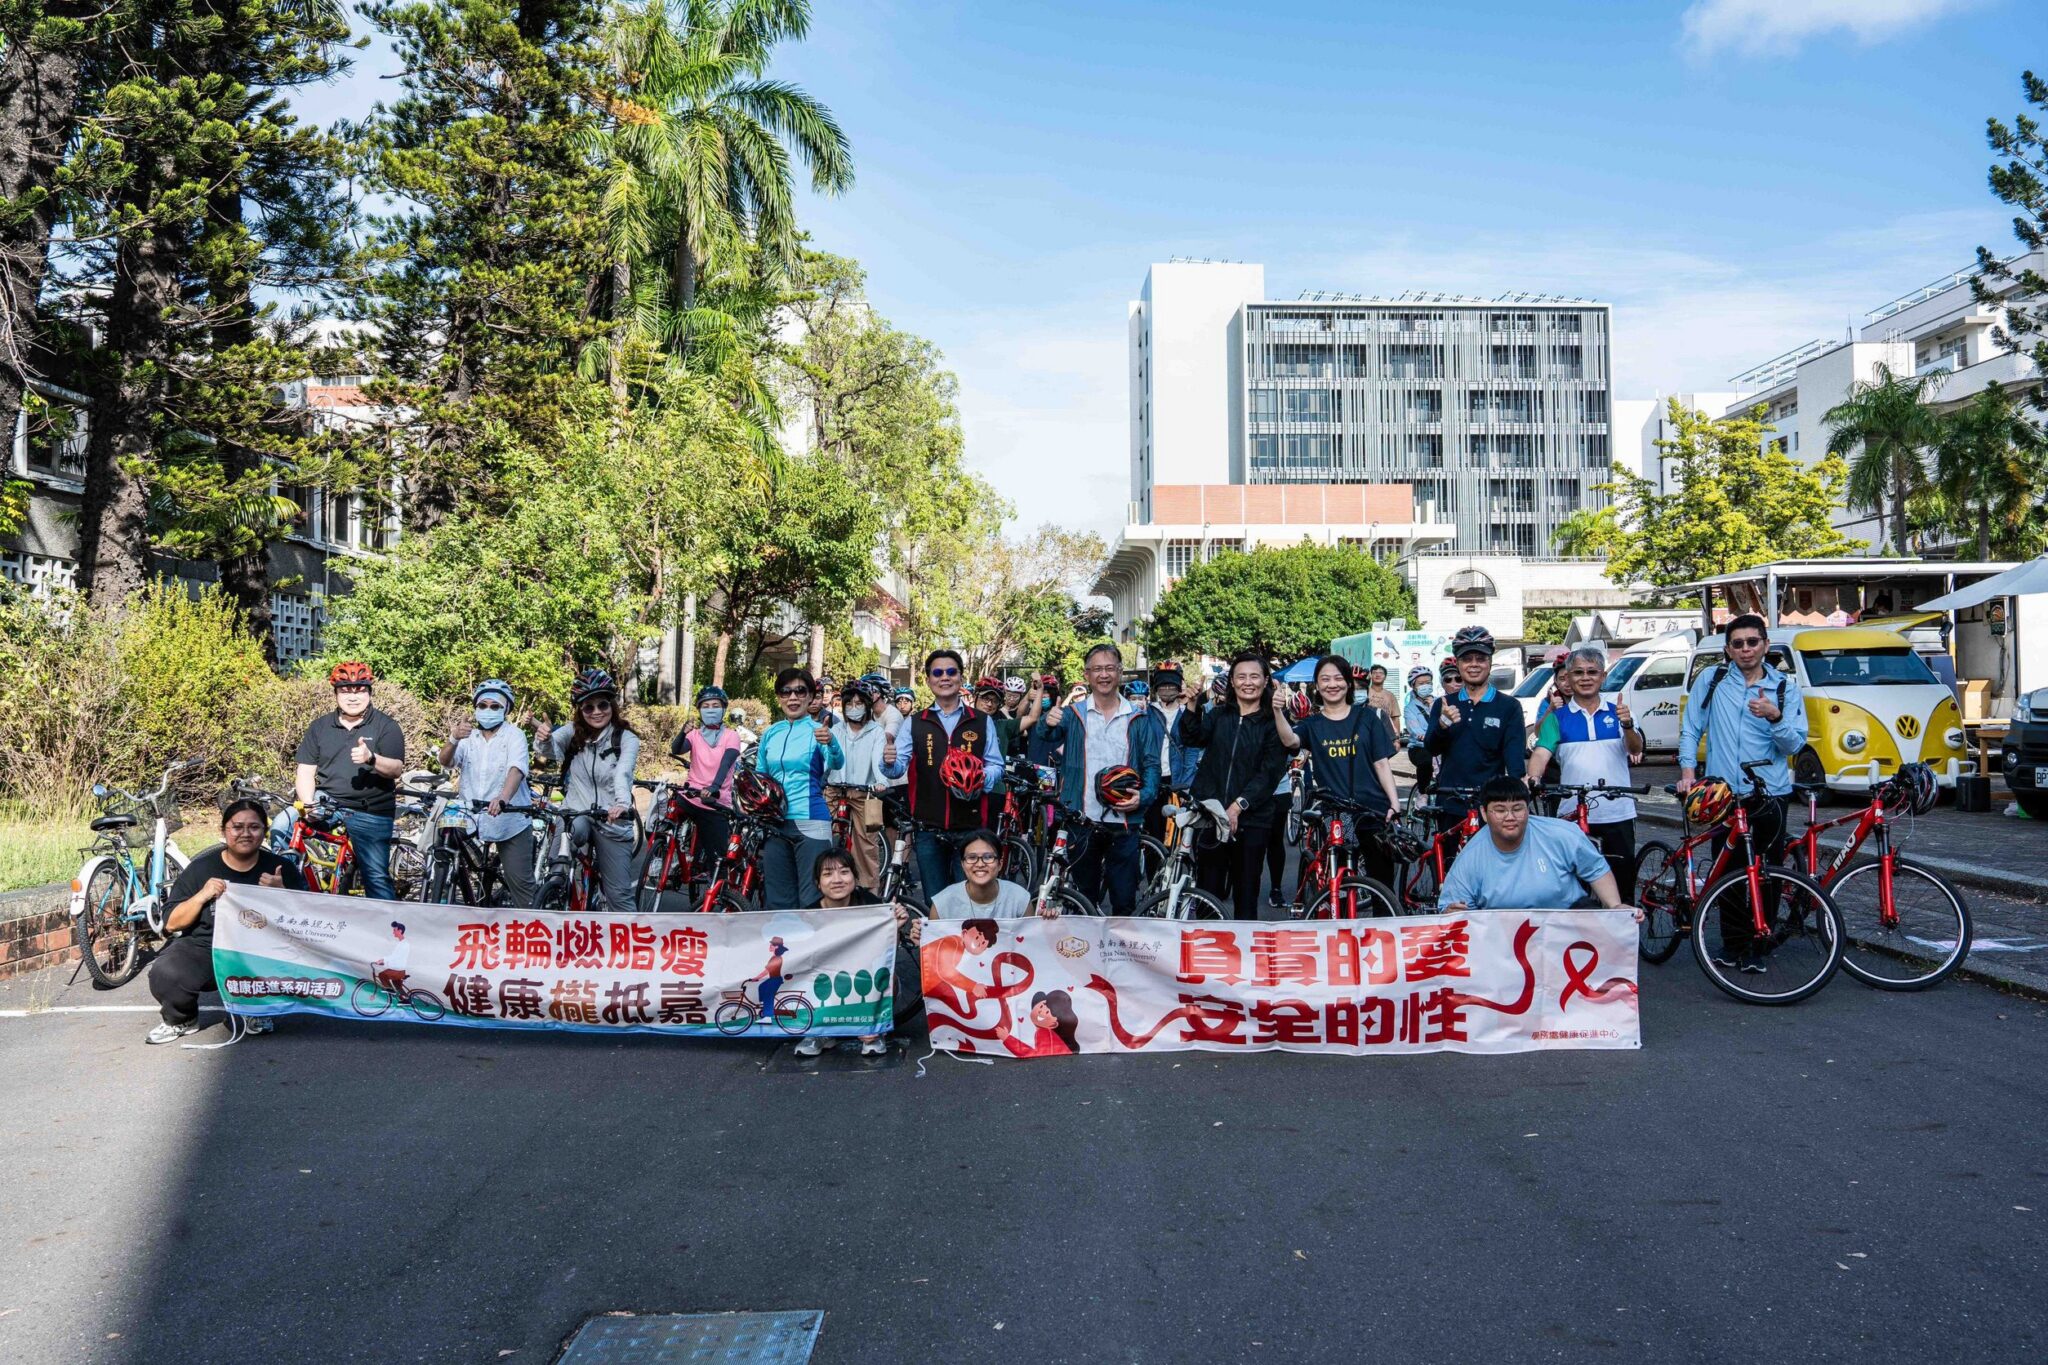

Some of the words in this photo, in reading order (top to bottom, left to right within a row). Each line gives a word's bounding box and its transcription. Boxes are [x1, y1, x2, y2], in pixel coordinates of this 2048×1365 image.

[449, 919, 708, 977] 飛輪燃脂瘦
[1175, 919, 1472, 987] 負責的愛
[227, 979, 341, 996] 健康促進系列活動
[442, 973, 708, 1024] 健康攏抵嘉
[1177, 986, 1469, 1047] 安全的性
